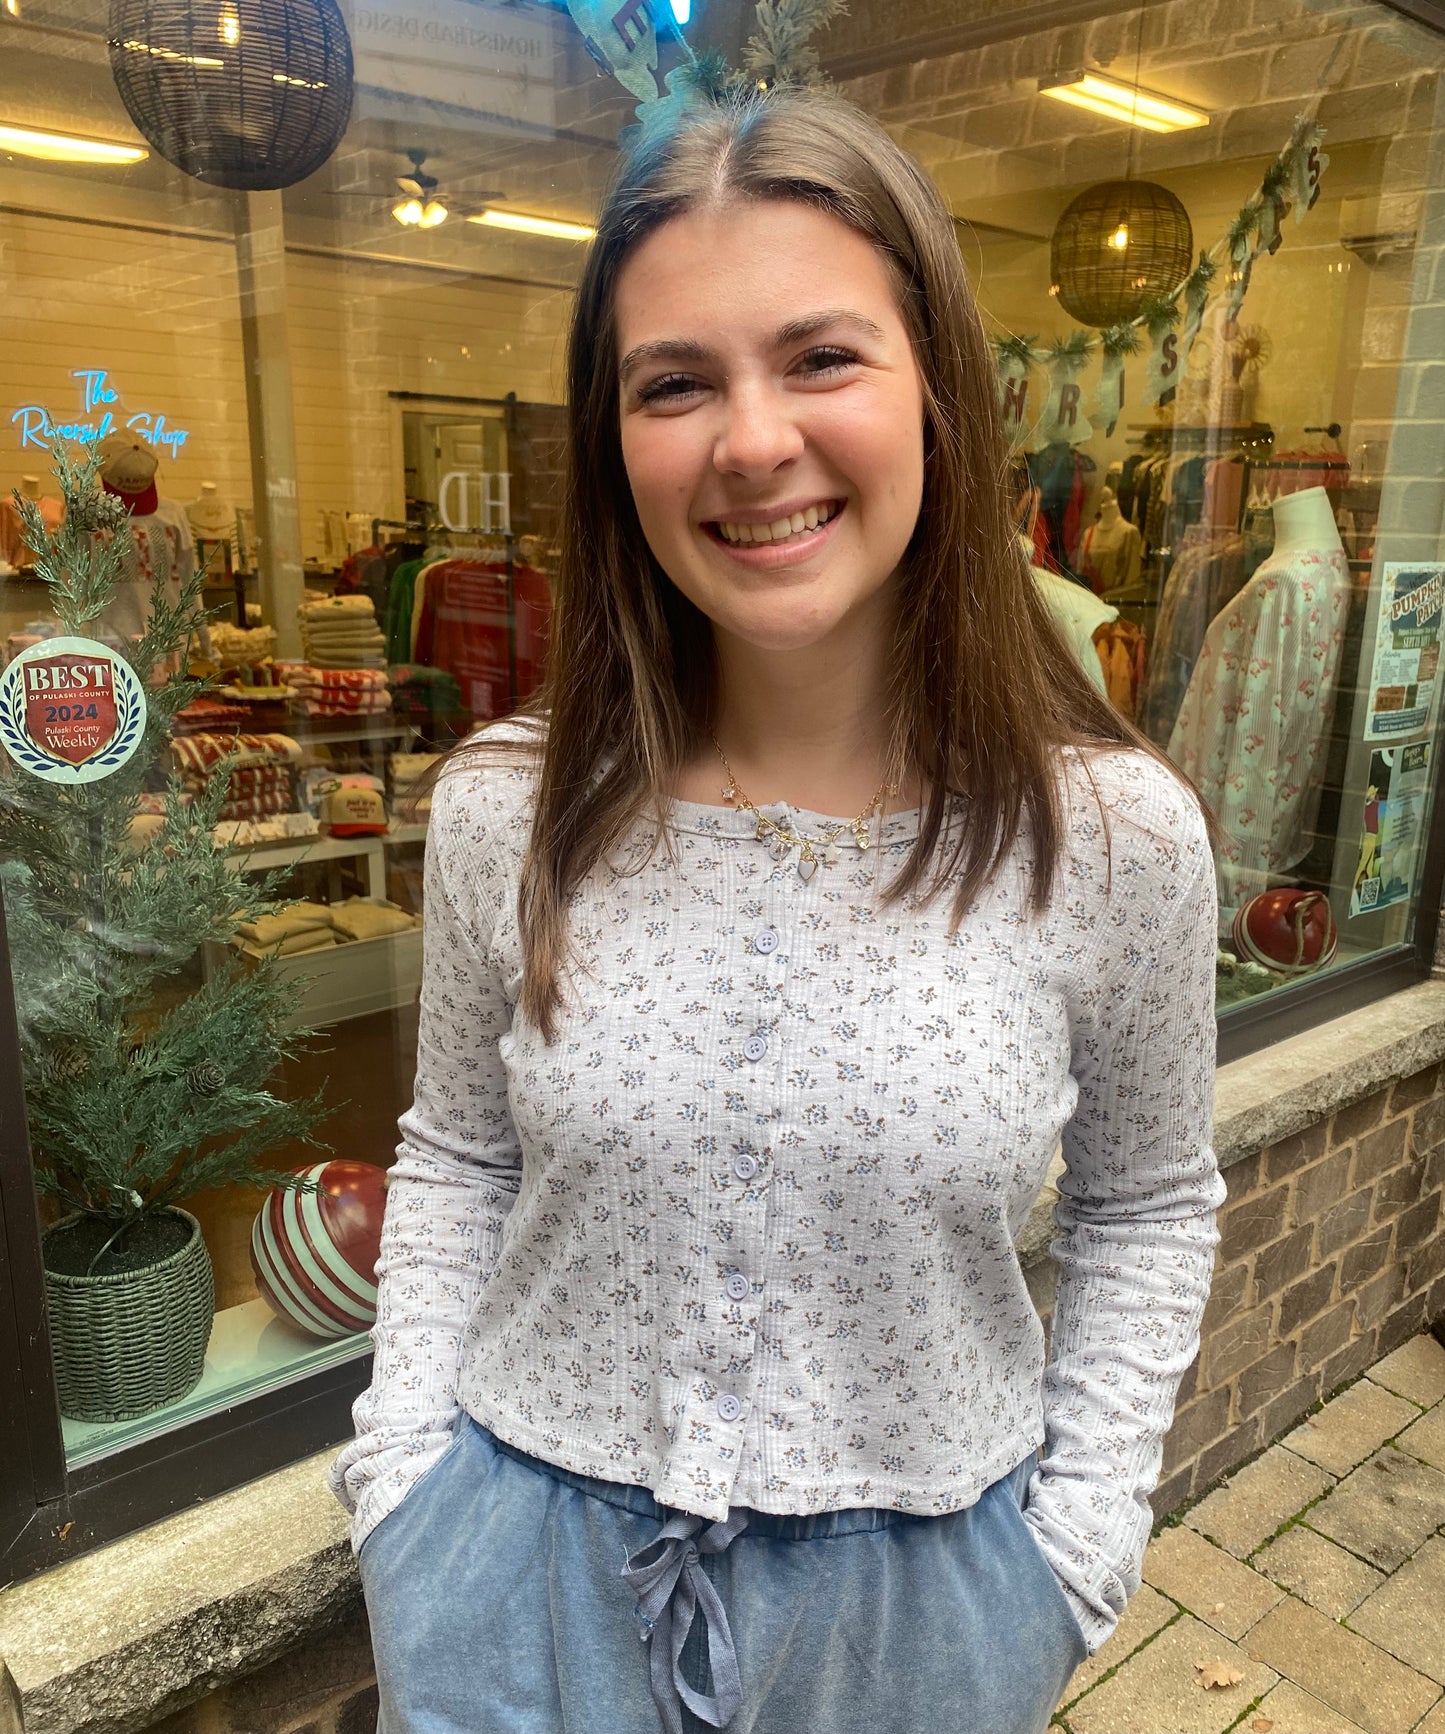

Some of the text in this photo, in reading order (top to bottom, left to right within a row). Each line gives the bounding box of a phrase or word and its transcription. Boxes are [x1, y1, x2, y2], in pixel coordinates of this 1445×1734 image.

[72, 369, 119, 414] The
[11, 406, 118, 450] Riversid
[28, 665, 109, 691] BEST
[43, 692, 77, 700] PULASKI
[45, 704, 98, 722] 2024
[45, 726, 72, 735] Pulaski
[46, 734, 99, 748] Weekly
